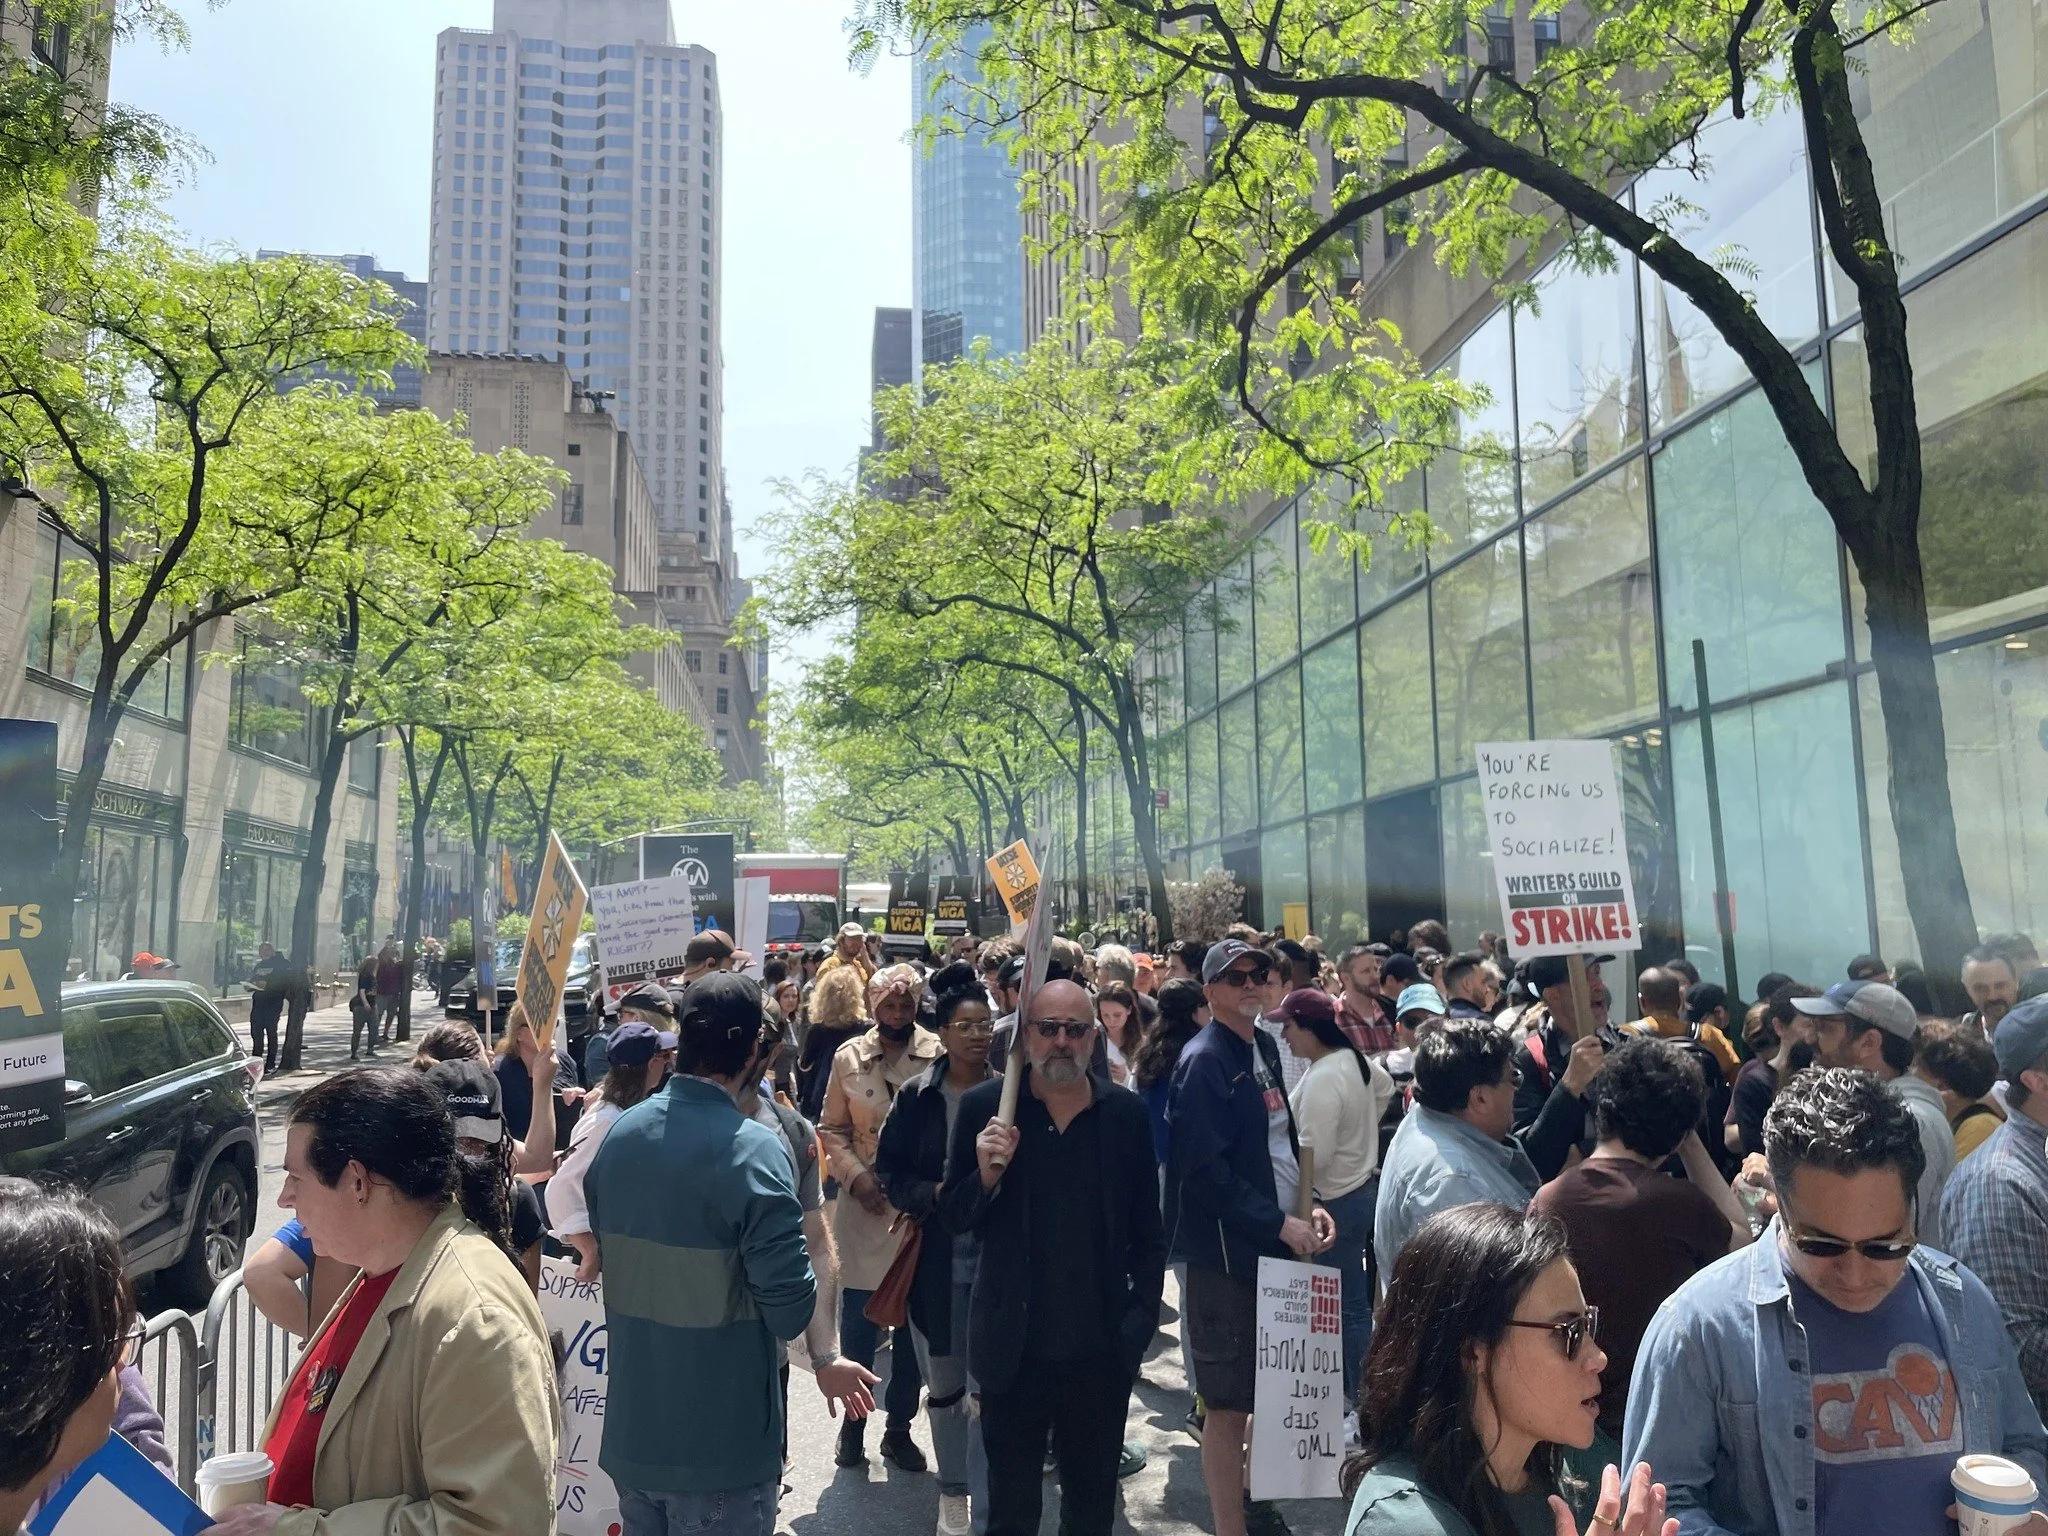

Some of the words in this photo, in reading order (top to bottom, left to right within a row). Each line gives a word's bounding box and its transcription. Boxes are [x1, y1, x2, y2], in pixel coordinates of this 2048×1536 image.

[1482, 753, 1551, 775] YOU'RE
[1488, 782, 1570, 800] FORCING
[1581, 783, 1604, 799] US
[1493, 811, 1516, 825] TO
[680, 845, 699, 854] The
[1501, 827, 1615, 856] SOCIALIZE!
[1504, 873, 1577, 894] WRITERS
[1579, 871, 1622, 889] GUILD
[698, 891, 718, 901] with
[1562, 892, 1579, 905] ON
[0, 903, 43, 940] TS
[938, 906, 966, 919] WGA
[890, 916, 923, 932] WGA
[1511, 904, 1632, 946] STRIKE!
[606, 960, 656, 977] WRITERS
[658, 955, 684, 969] GUIL
[0, 948, 44, 1017] A
[4, 1054, 47, 1071] Future
[0, 1109, 27, 1121] orming
[27, 1107, 41, 1116] any
[0, 1121, 12, 1130] ort
[13, 1119, 27, 1128] any
[539, 1266, 602, 1304] SUPPOR
[1289, 1278, 1309, 1290] EAST
[1262, 1287, 1300, 1300] AMERICA
[1284, 1301, 1309, 1313] GUILD
[1274, 1311, 1308, 1324] WRITERS
[1259, 1326, 1306, 1374] MUCH
[1313, 1347, 1341, 1374] TOO
[561, 1384, 608, 1416] AFFE
[1283, 1405, 1319, 1430] STEP
[1297, 1432, 1337, 1460] TWO
